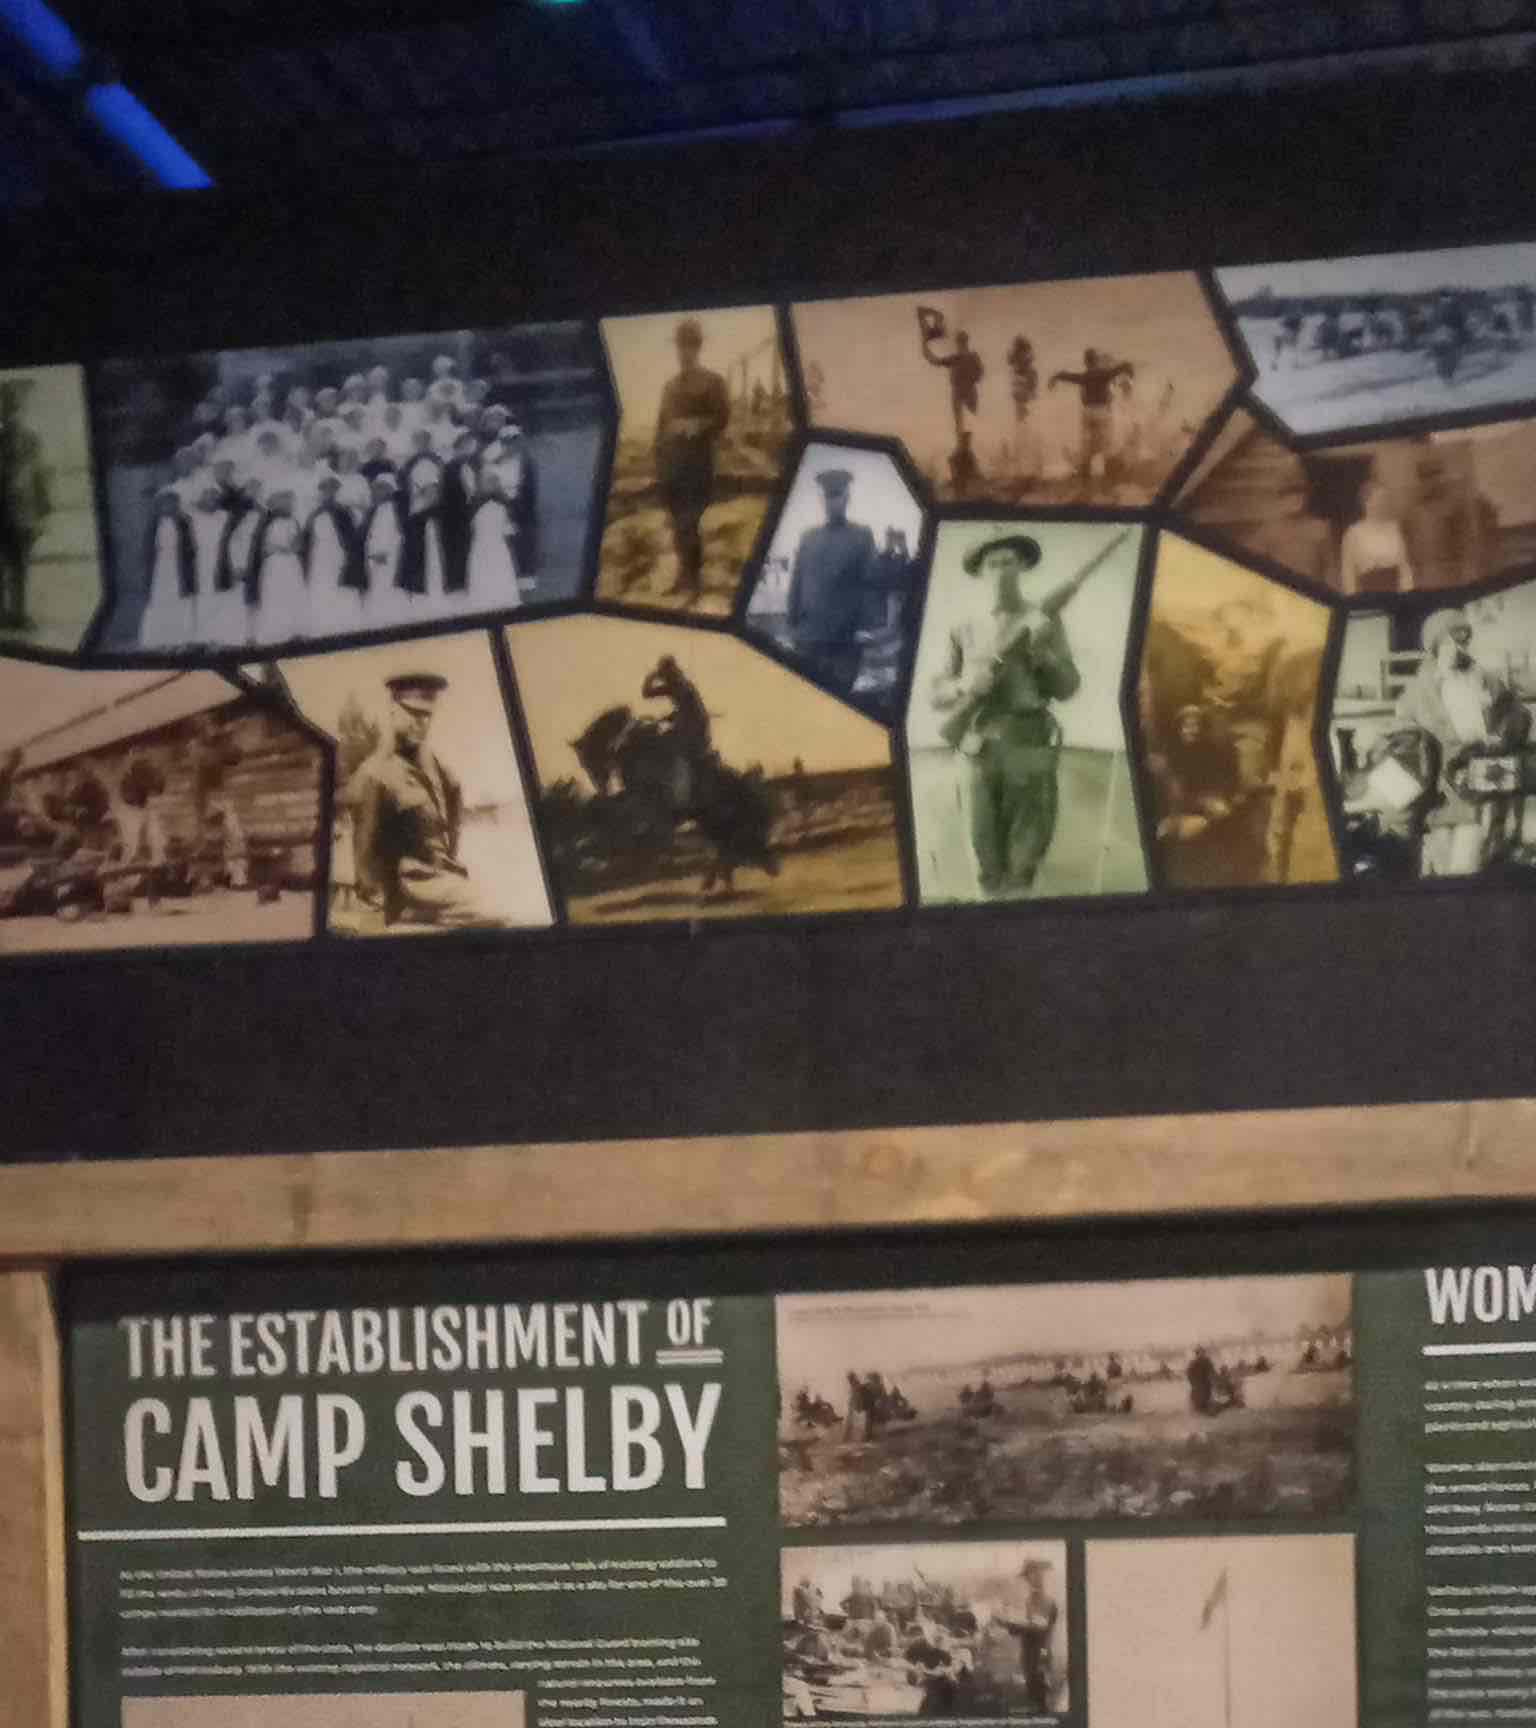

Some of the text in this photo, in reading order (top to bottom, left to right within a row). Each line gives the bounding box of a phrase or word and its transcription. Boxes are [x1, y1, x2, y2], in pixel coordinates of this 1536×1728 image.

[120, 1298, 713, 1379] THE ESTABLISHMENT OF
[124, 1382, 722, 1502] CAMP SHELBY
